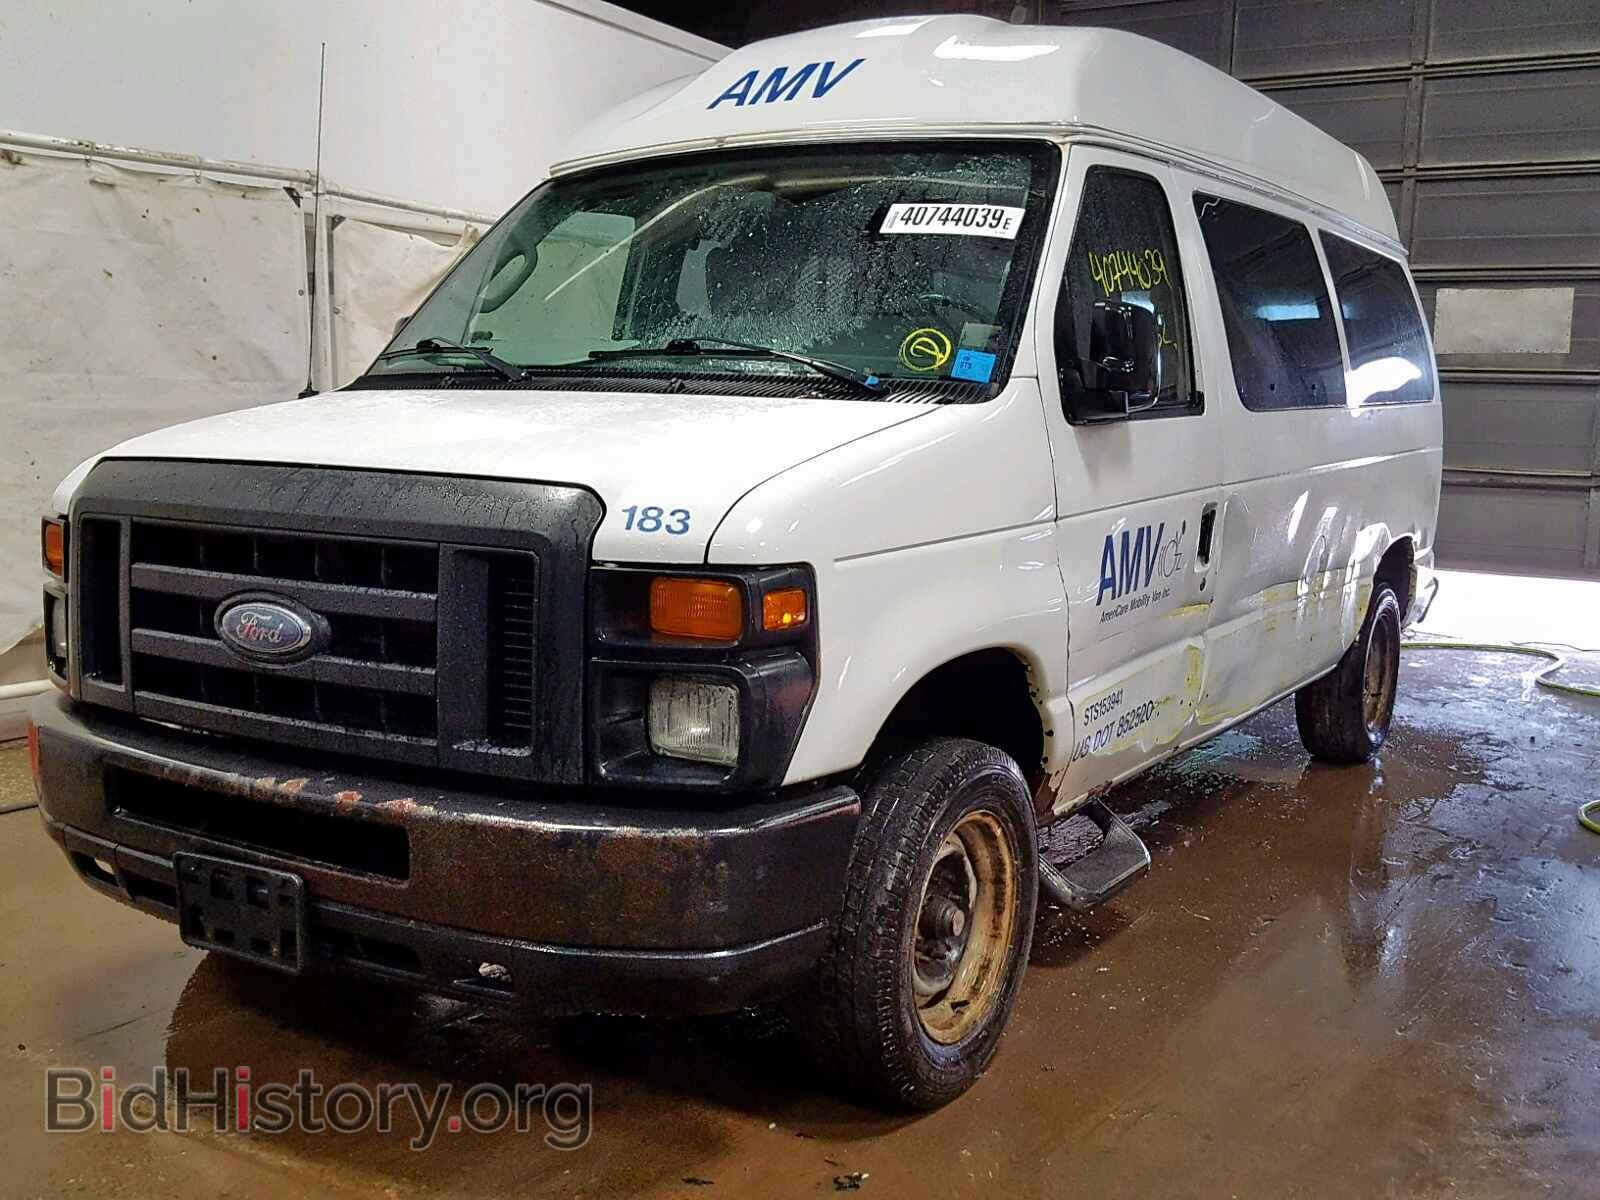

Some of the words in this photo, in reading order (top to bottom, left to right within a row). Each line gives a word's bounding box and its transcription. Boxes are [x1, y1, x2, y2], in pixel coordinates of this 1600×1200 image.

[706, 58, 867, 110] AMV
[621, 505, 691, 535] 183
[1096, 522, 1165, 606] AMV
[1130, 594, 1151, 610] Mobility
[236, 611, 284, 643] Ford
[1083, 688, 1124, 727] STS153941
[1072, 735, 1091, 762] US
[1093, 721, 1116, 752] DOT
[1116, 700, 1155, 738] 852520
